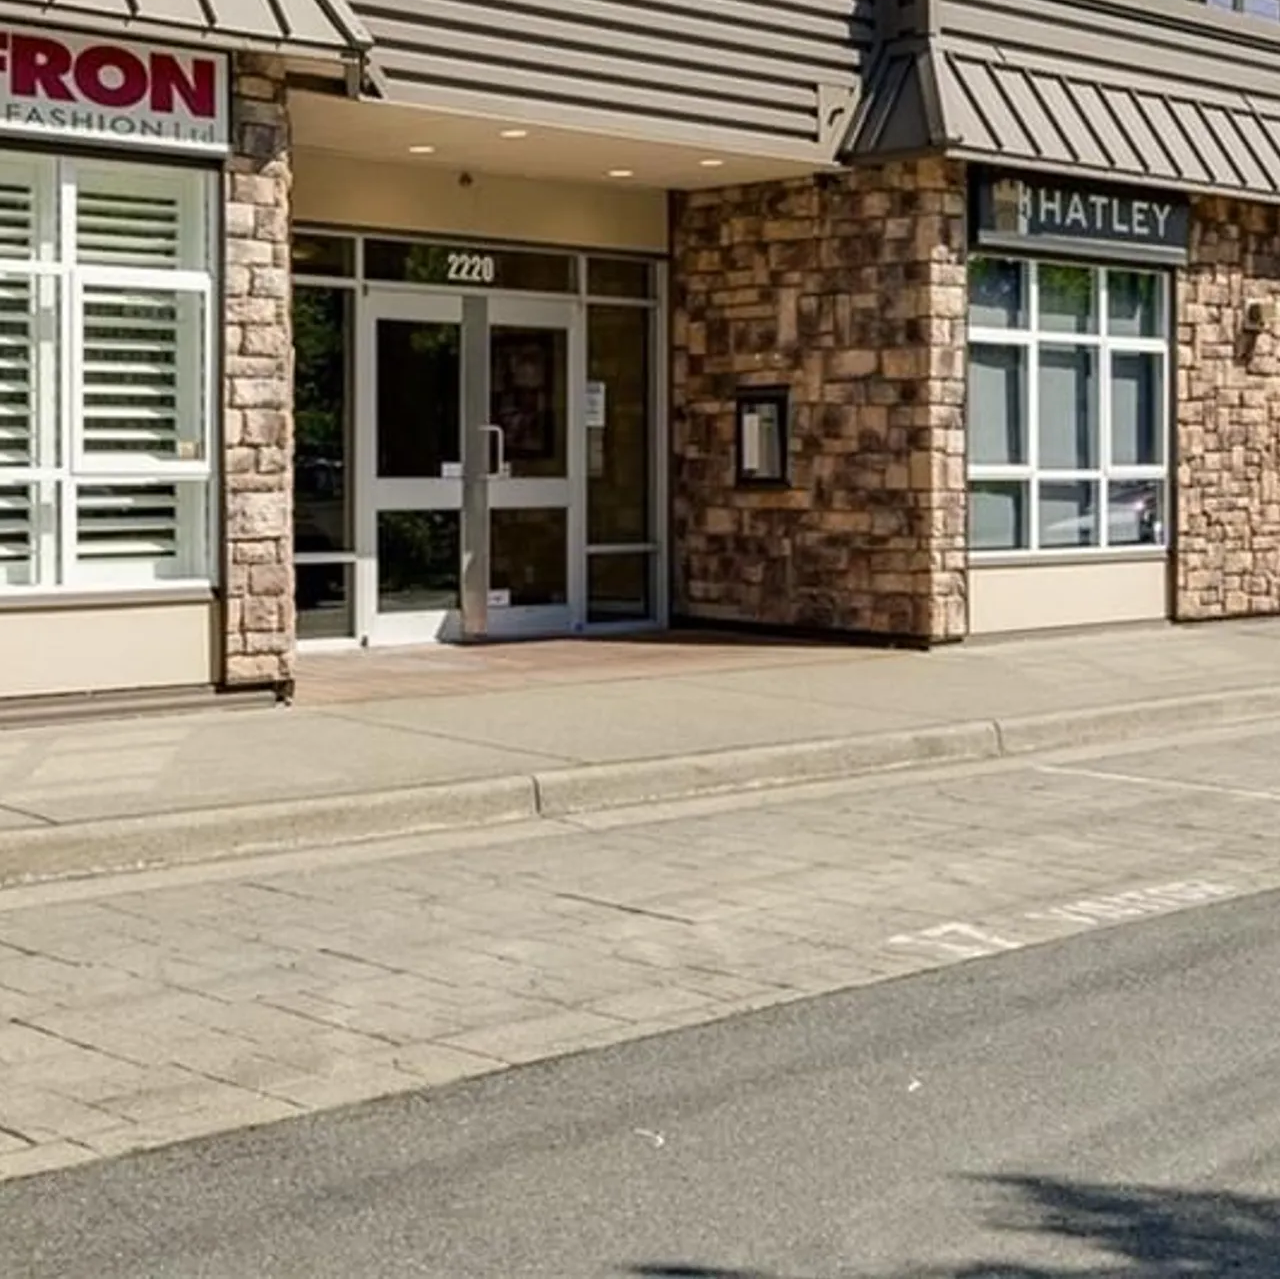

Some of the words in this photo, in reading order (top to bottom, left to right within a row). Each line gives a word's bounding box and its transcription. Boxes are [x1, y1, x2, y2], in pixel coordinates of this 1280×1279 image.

[5, 105, 163, 139] FASHION
[1039, 188, 1171, 239] HATLEY
[448, 253, 494, 282] 2220
